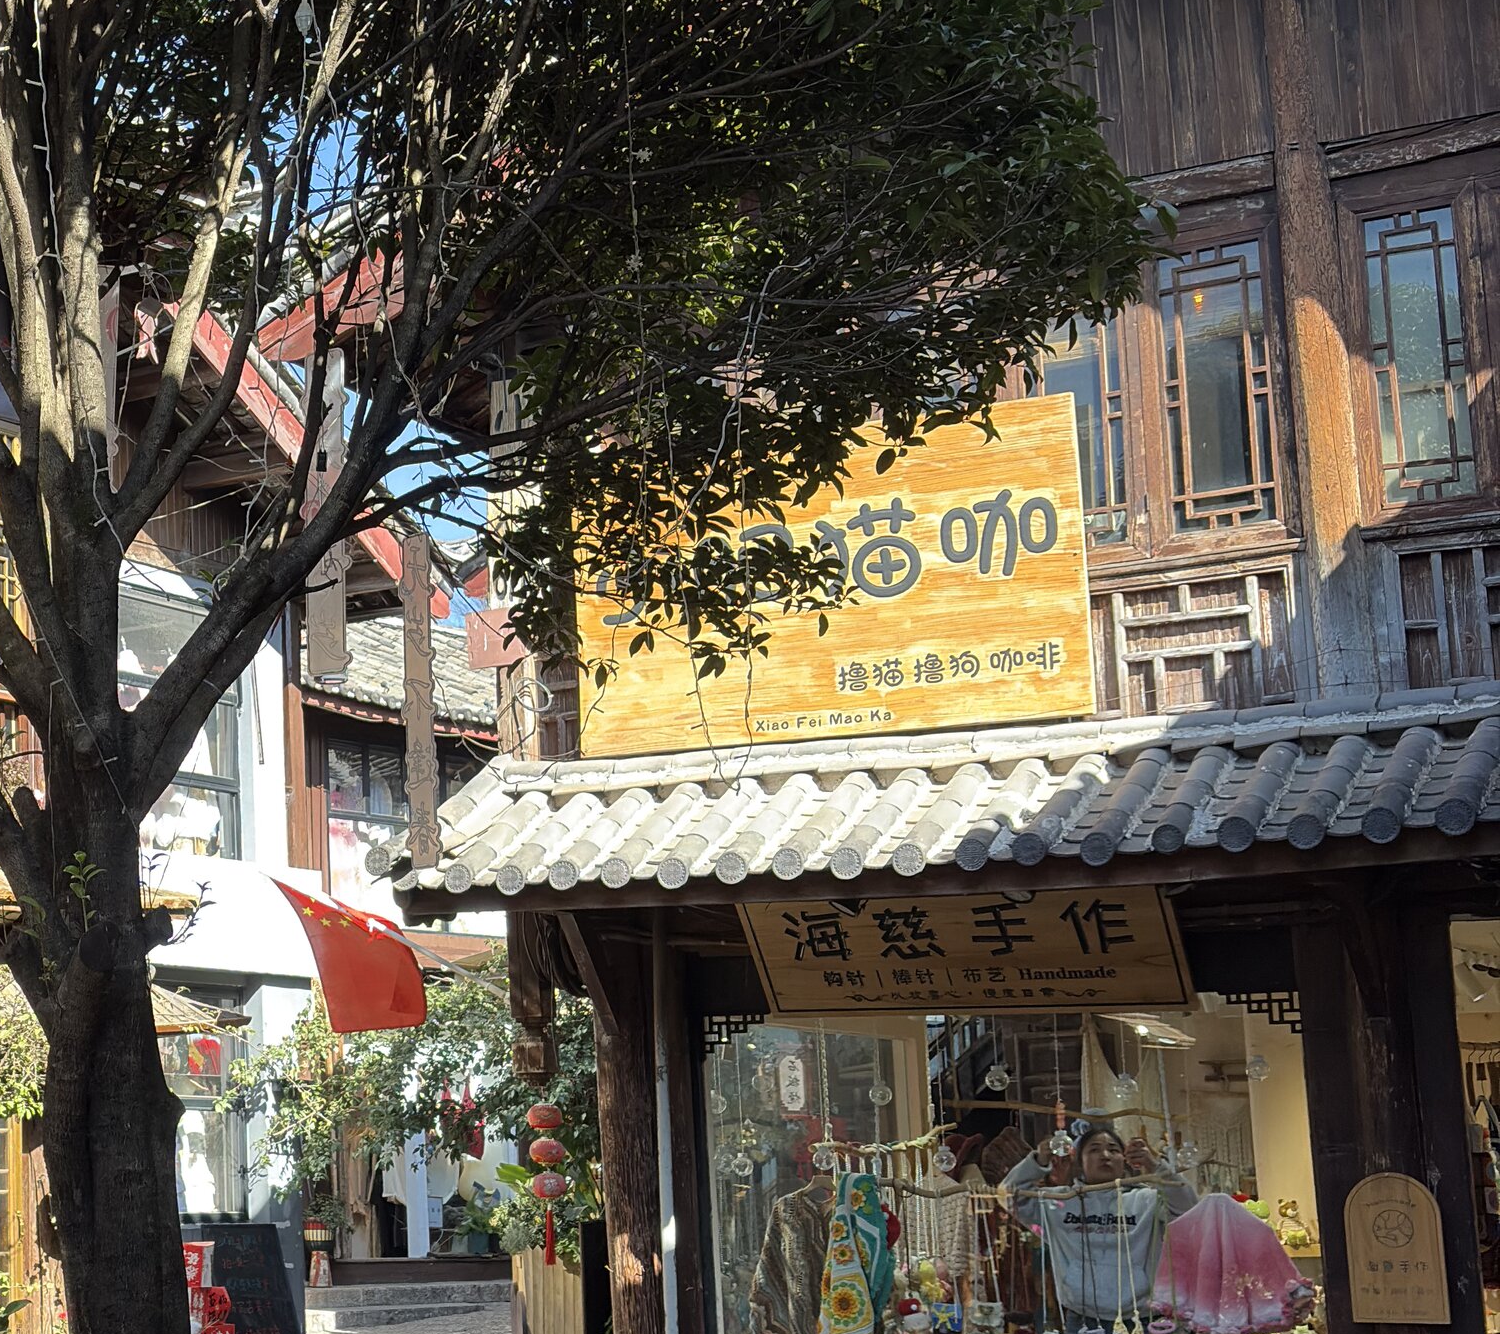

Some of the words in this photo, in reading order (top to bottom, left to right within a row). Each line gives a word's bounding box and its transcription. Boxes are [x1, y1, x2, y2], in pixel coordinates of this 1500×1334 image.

[838, 658, 905, 692] 撸猫
[913, 651, 980, 684] 撸狗
[990, 642, 1061, 673] 咖啡
[755, 717, 790, 732] Xiao
[796, 715, 824, 730] Fei
[829, 712, 864, 727] Mao
[870, 709, 893, 723] Ka
[781, 900, 1135, 961] 海慈手作
[961, 966, 1008, 984] 布艺
[1018, 964, 1118, 981] Handmade
